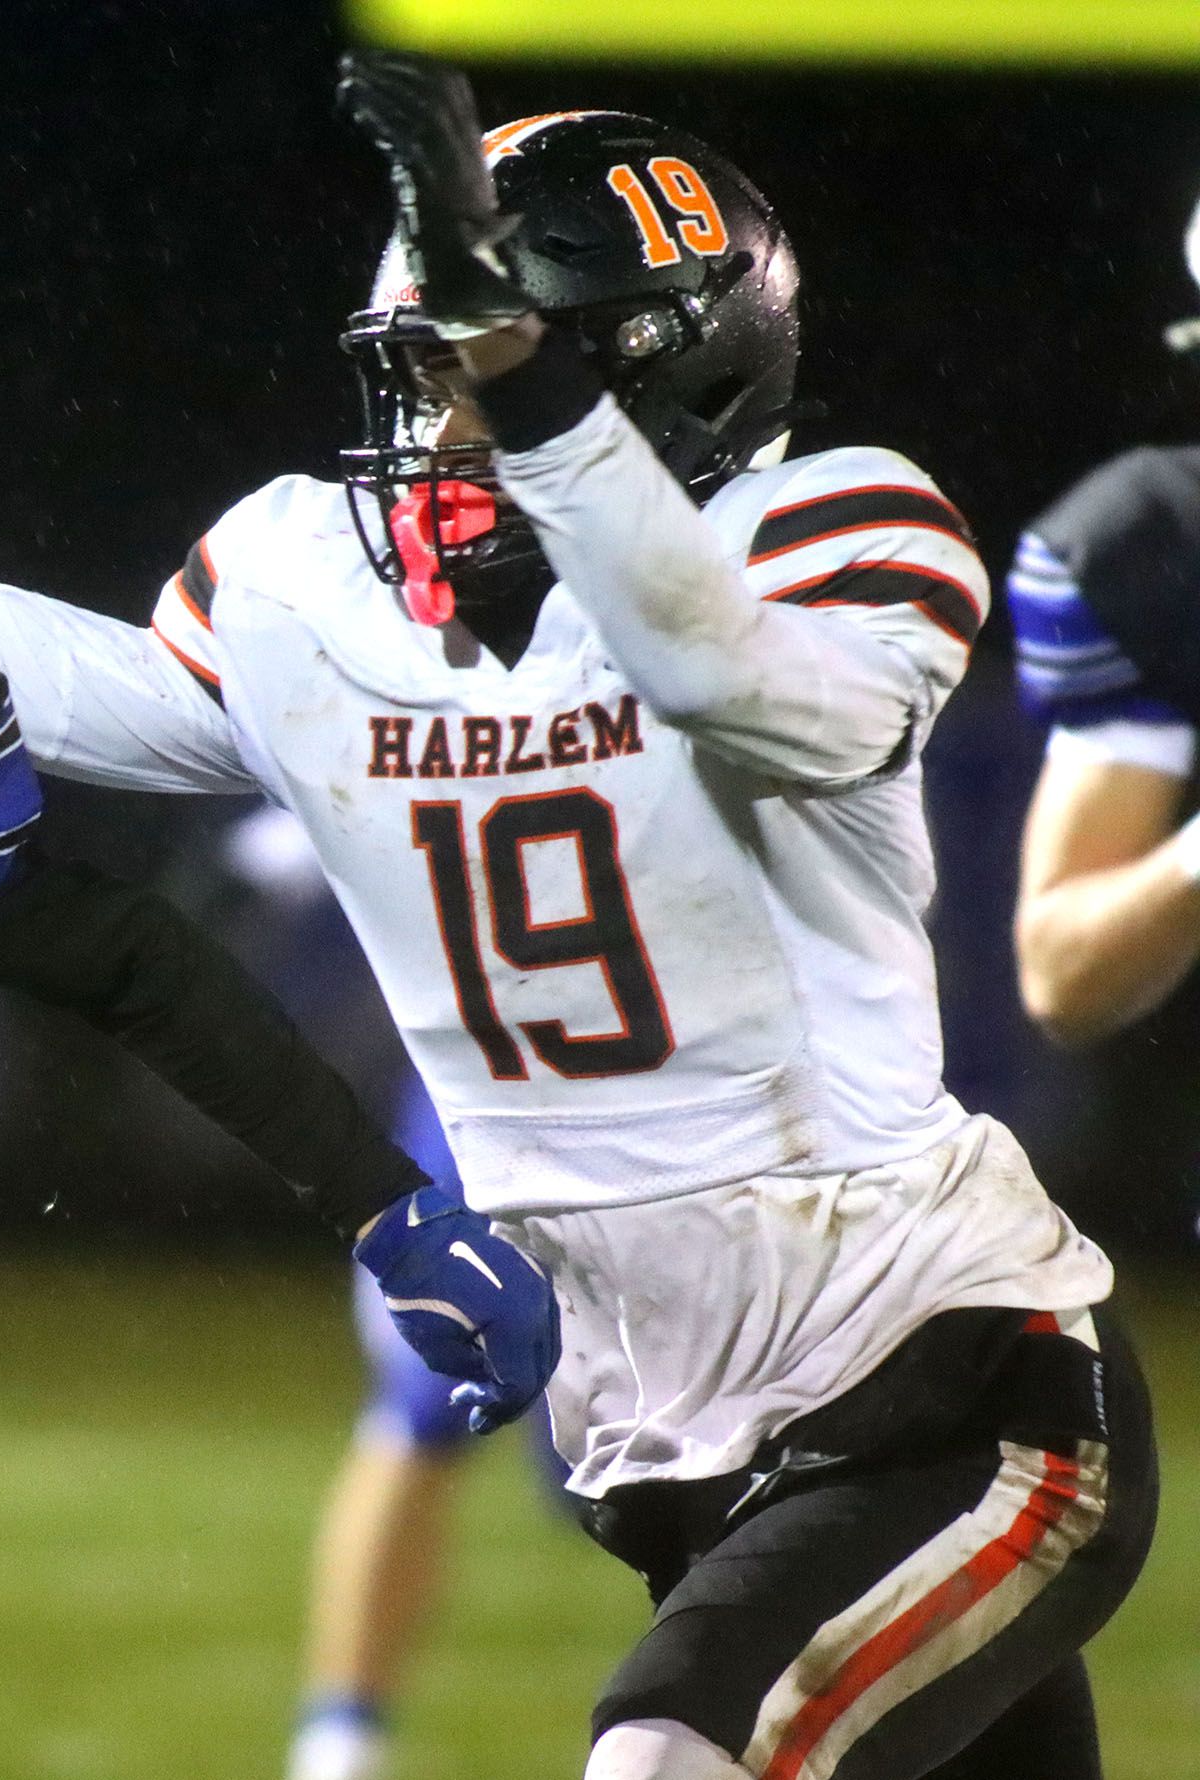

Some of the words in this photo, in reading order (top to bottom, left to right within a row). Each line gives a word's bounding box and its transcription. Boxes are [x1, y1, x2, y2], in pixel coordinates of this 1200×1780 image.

[607, 156, 729, 268] 19
[368, 693, 644, 778] HARLEM
[410, 785, 676, 1080] 19
